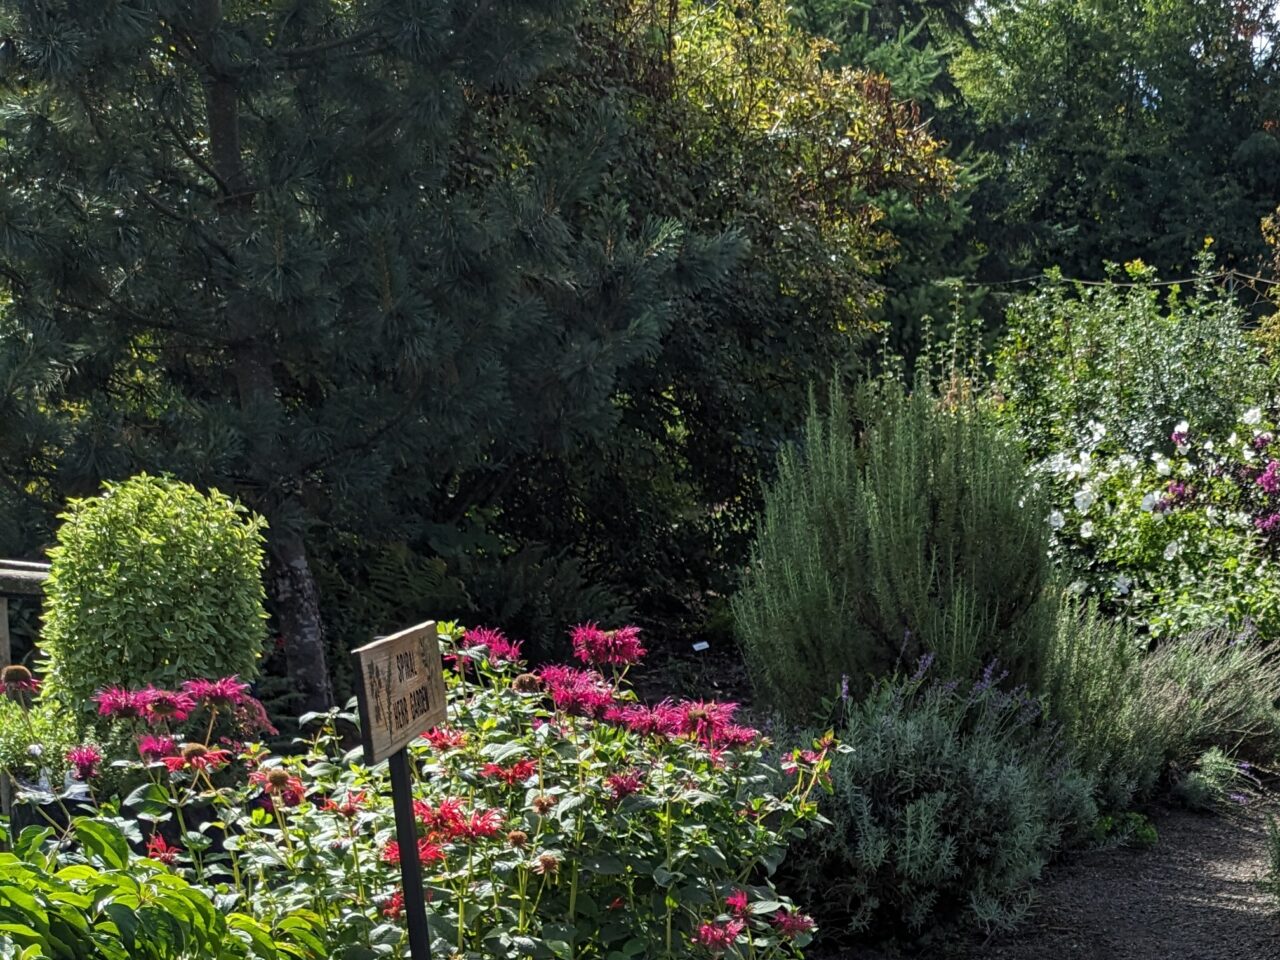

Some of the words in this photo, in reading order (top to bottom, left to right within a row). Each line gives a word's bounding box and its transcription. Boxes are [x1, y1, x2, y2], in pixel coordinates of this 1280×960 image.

[396, 651, 417, 683] SPIRAL
[393, 697, 409, 729] HERB
[410, 686, 430, 721] GARDEN
